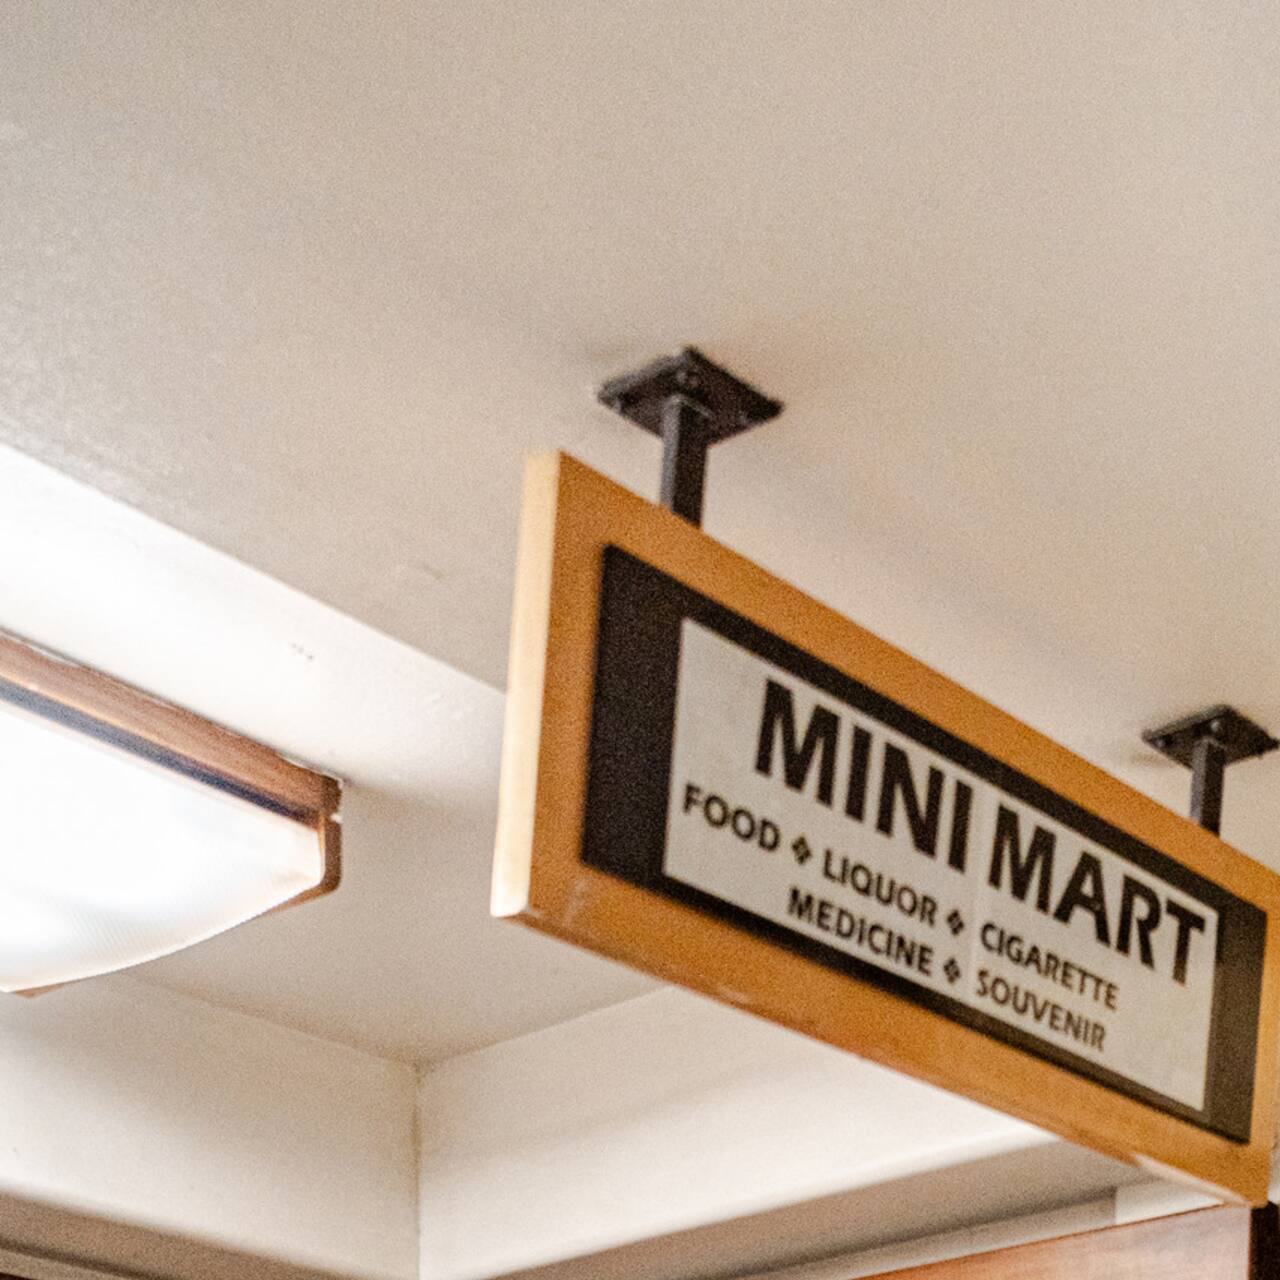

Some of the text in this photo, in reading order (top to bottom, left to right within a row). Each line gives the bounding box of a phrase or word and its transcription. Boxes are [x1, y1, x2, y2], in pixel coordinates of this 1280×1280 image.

[681, 782, 1121, 1013] FOOD LIQUOR CIGARETTE
[753, 675, 1208, 989] MINI MART
[786, 887, 1108, 1054] MEDICINE SOUVENIR
